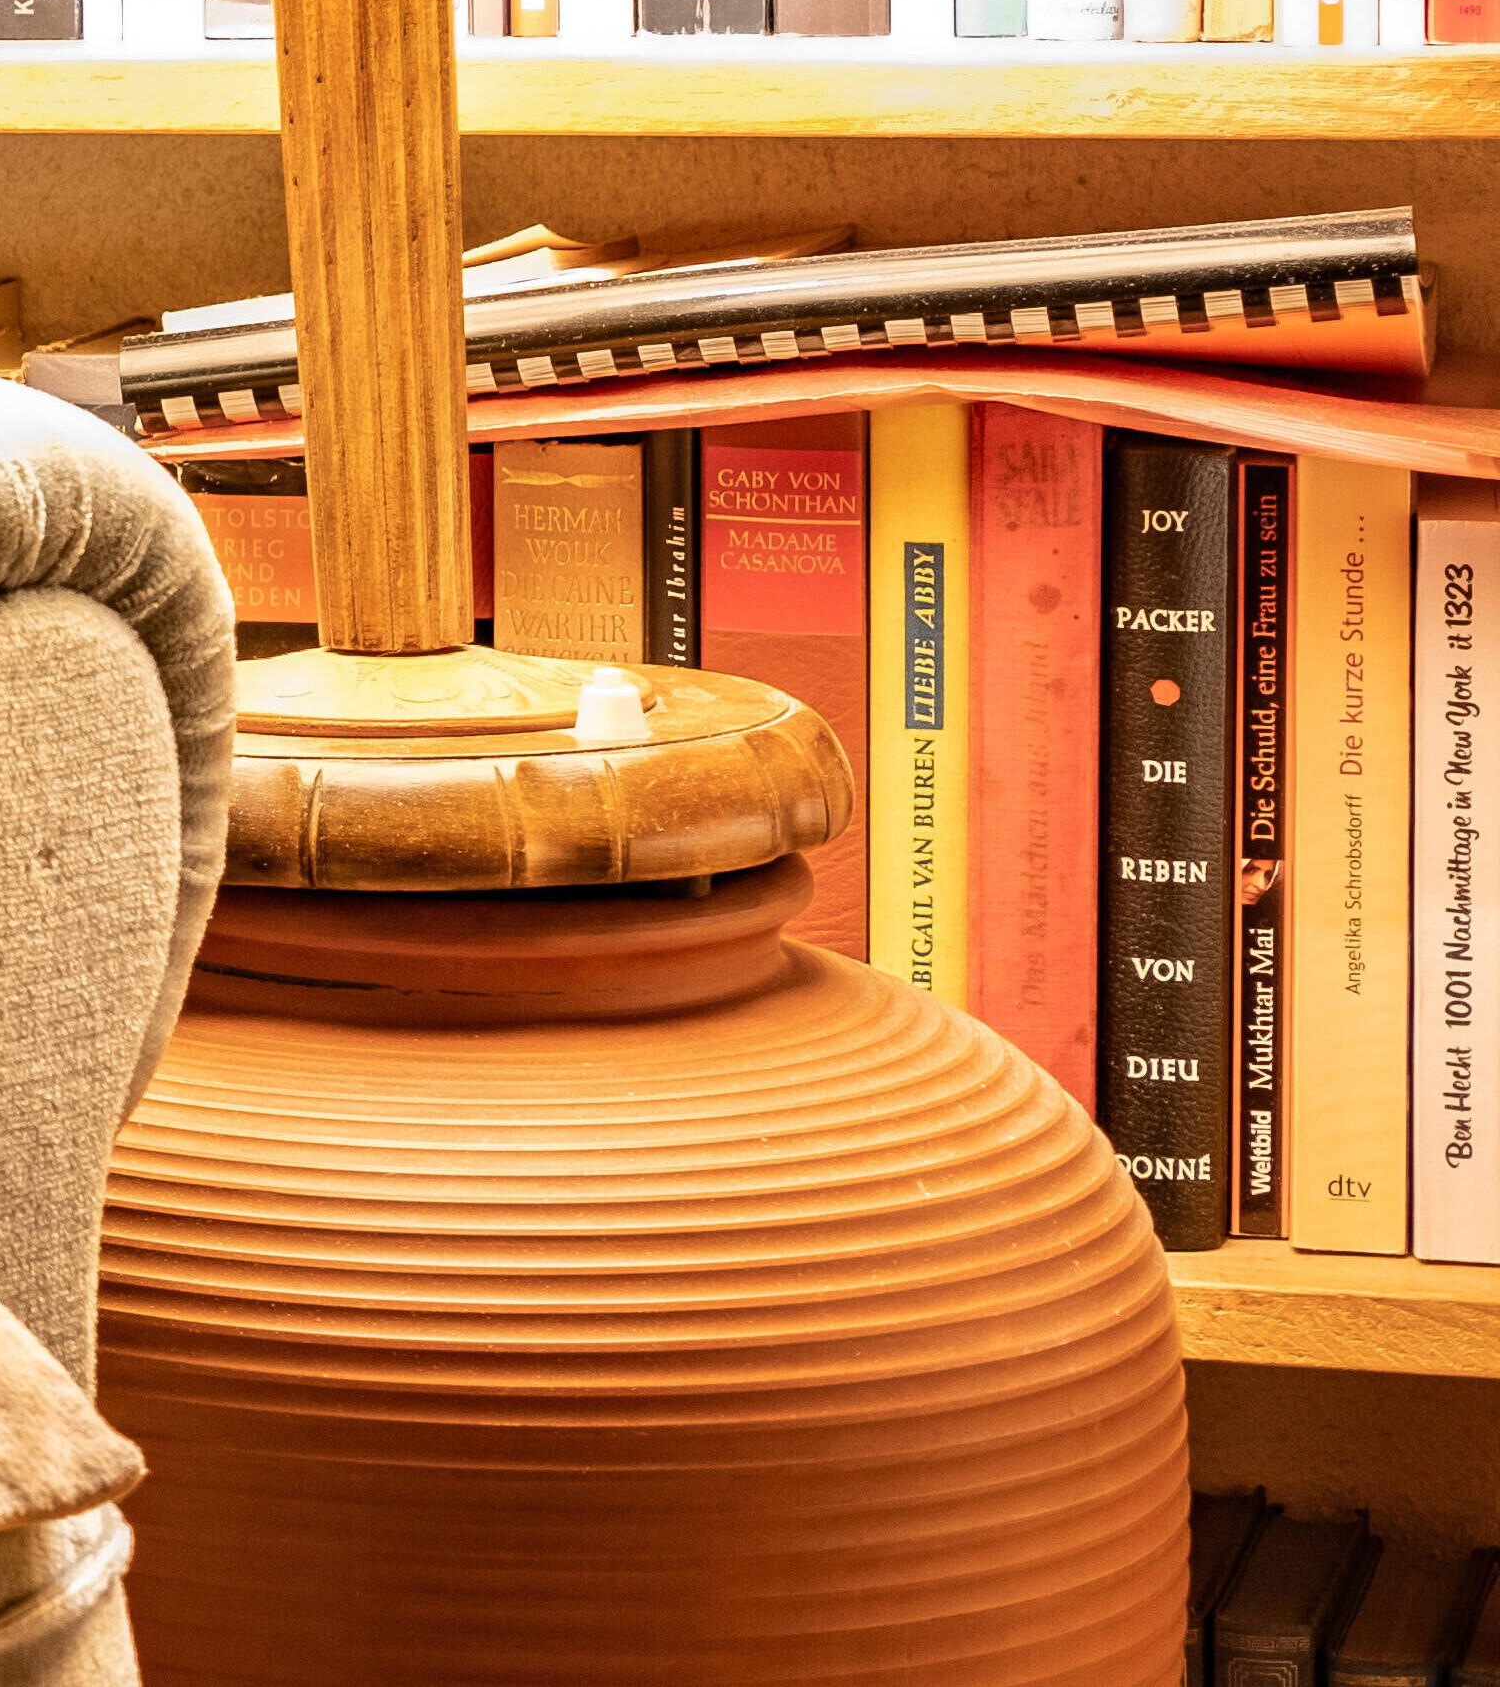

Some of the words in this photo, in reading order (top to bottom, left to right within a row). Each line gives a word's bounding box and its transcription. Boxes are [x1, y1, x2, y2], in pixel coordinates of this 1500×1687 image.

[708, 489, 858, 515] SCHÖNTHAN
[716, 468, 780, 490] GABY
[788, 471, 842, 491] VON
[514, 504, 622, 535] HERMAN
[727, 529, 838, 552] MADAME
[1142, 509, 1188, 535] JOY
[1251, 493, 1277, 542] sein
[525, 536, 610, 567] WOUK
[665, 505, 687, 601] Ibrahim
[719, 552, 847, 576] CASANOVA
[1258, 549, 1277, 578] zu
[912, 548, 936, 629] ABBY
[1252, 584, 1277, 639] Frau
[1338, 551, 1364, 642] Stunde
[1443, 562, 1473, 627] 1323
[1115, 606, 1217, 635] PACKER
[1447, 634, 1473, 650] it
[913, 637, 937, 725] LIEBE
[1252, 645, 1277, 696] eine
[1338, 652, 1363, 724] kurze
[1444, 664, 1480, 726] York
[1250, 701, 1280, 793] Schuld,
[1338, 734, 1364, 776] Die
[1443, 730, 1472, 786] New
[912, 738, 936, 828] BUREN
[1142, 760, 1187, 785] DIE
[1250, 798, 1276, 841] Die
[1446, 790, 1471, 810] in
[912, 837, 935, 887] VAN
[1119, 858, 1207, 885] REBEN
[1342, 793, 1363, 911] Schrobsdorff
[1443, 815, 1480, 962] Nachmittage
[1131, 959, 1195, 985] VON
[1249, 927, 1275, 975] Mai
[1342, 917, 1365, 996] Angelika
[1444, 970, 1473, 1028] 1001
[1248, 980, 1275, 1091] Mukhtar
[1126, 1056, 1200, 1083] DIEU
[1444, 1046, 1473, 1112] Hecht
[1250, 1109, 1272, 1197] Weltbild
[1445, 1117, 1474, 1168] Ben
[1326, 1175, 1371, 1199] dtv
